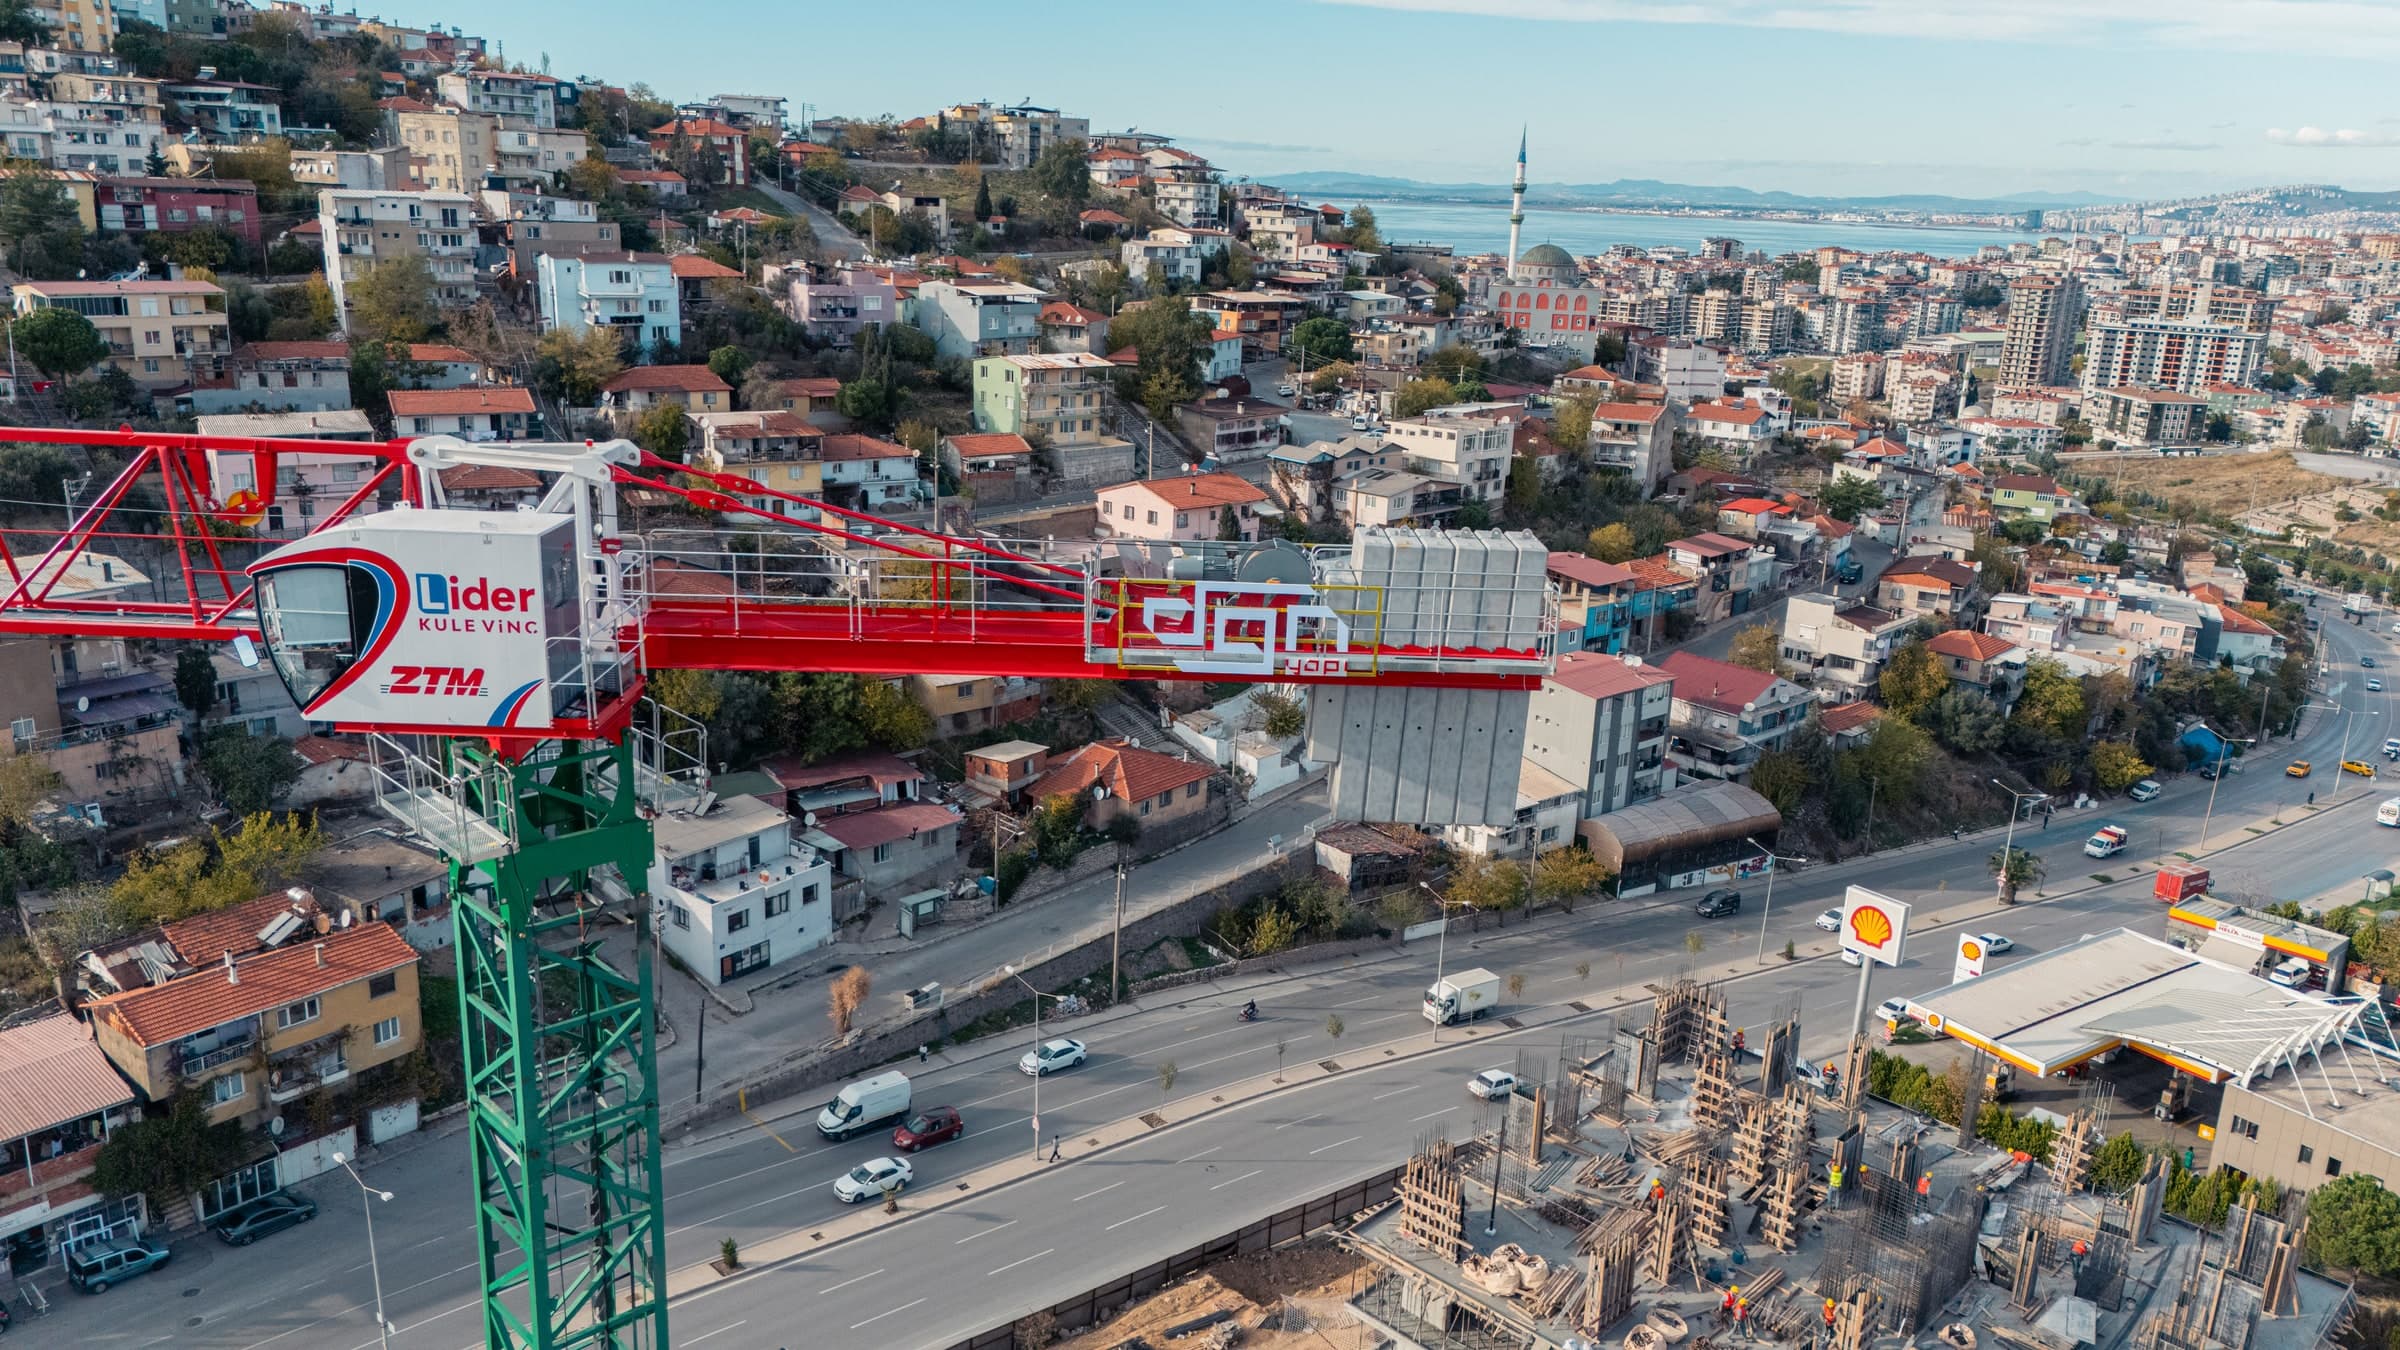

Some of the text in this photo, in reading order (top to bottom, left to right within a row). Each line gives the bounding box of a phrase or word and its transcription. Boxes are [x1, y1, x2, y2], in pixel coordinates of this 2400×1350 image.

[415, 573, 535, 615] Lider
[419, 617, 476, 632] KULE
[389, 665, 485, 696] ZTM
